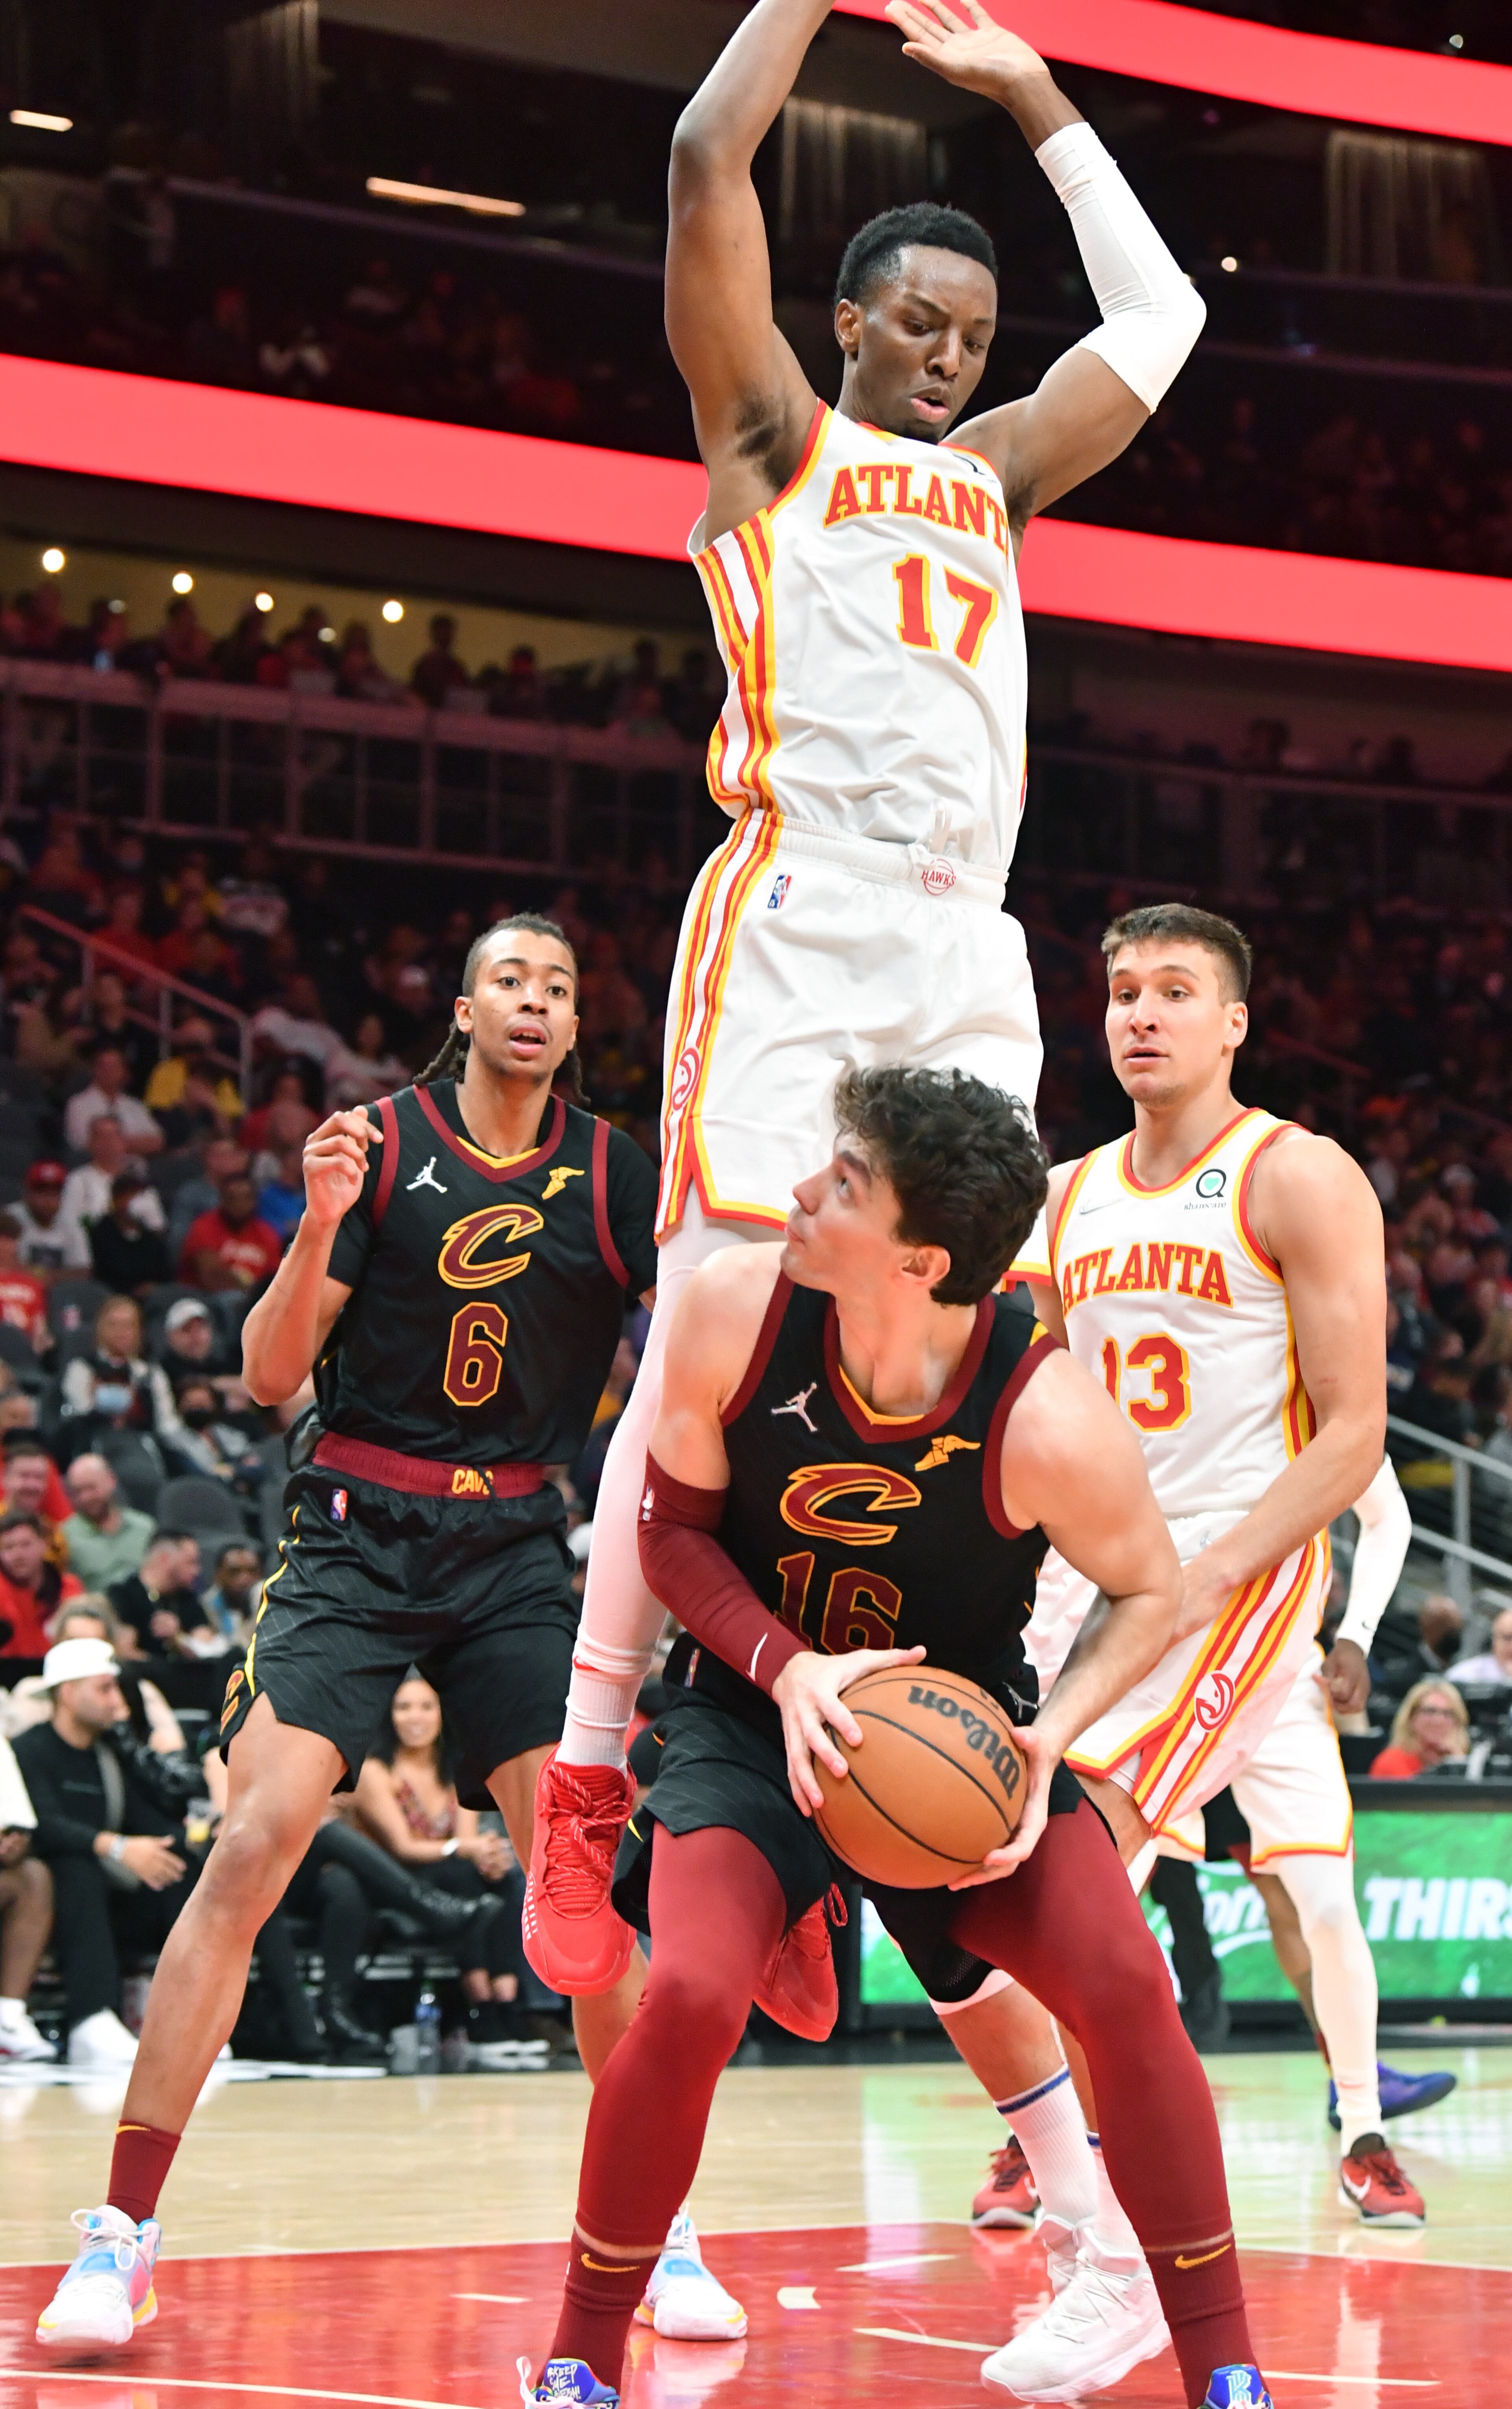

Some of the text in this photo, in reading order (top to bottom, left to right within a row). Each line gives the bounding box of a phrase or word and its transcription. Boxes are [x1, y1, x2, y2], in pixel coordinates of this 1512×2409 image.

[823, 463, 1008, 557] ATLANT
[892, 553, 999, 669] 17
[921, 870, 956, 886] HAWKS
[438, 1203, 543, 1289] C
[1062, 1242, 1234, 1320] ATLANTA
[443, 1301, 508, 1406] 6
[1101, 1332, 1191, 1433] 13
[780, 1462, 922, 1546] C
[774, 1551, 902, 1655] 16
[907, 1685, 1020, 1800] Wilson
[1364, 1876, 1512, 1941] THIR
